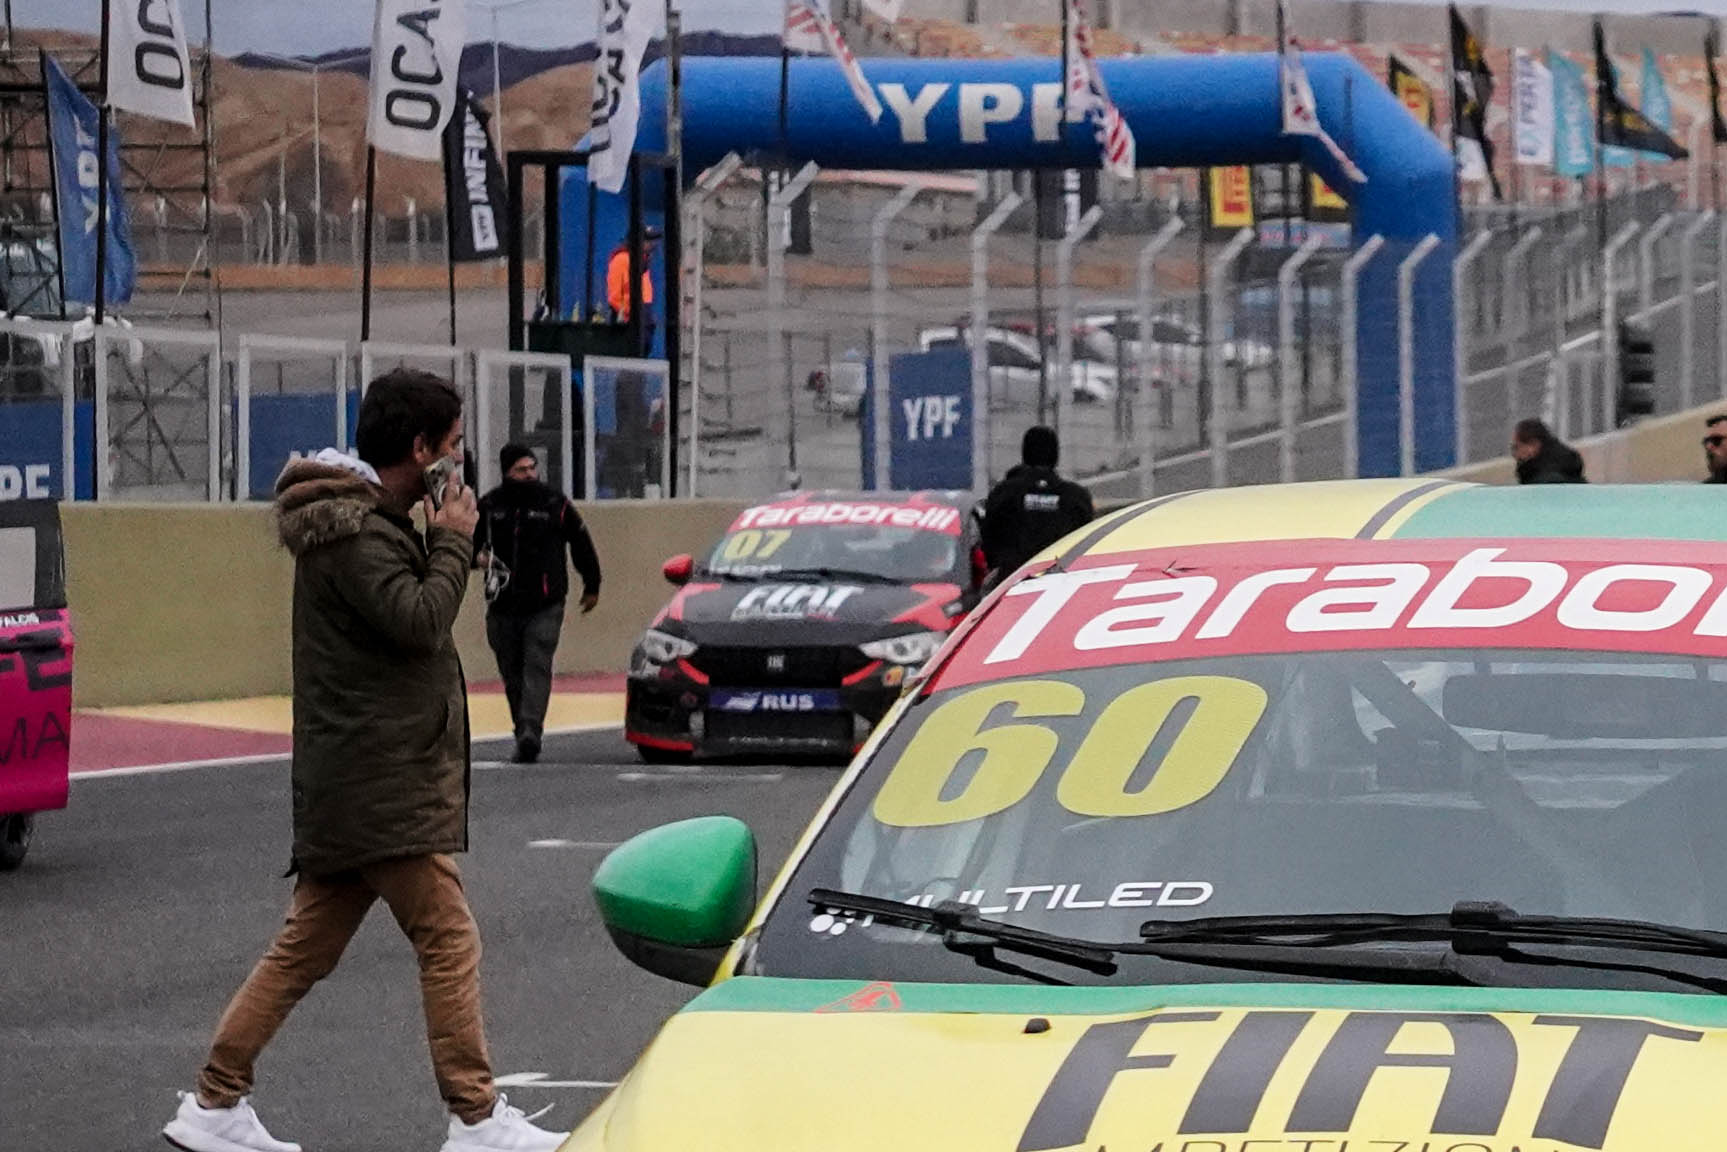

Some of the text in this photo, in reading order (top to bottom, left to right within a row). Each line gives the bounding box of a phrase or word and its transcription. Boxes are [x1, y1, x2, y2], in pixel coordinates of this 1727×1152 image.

[902, 395, 961, 440] YPF
[739, 503, 959, 530] Taraborelli
[724, 529, 793, 559] 07
[761, 694, 815, 711] RUS
[872, 674, 1268, 828] 60
[1015, 1009, 1704, 1152] FIAT
